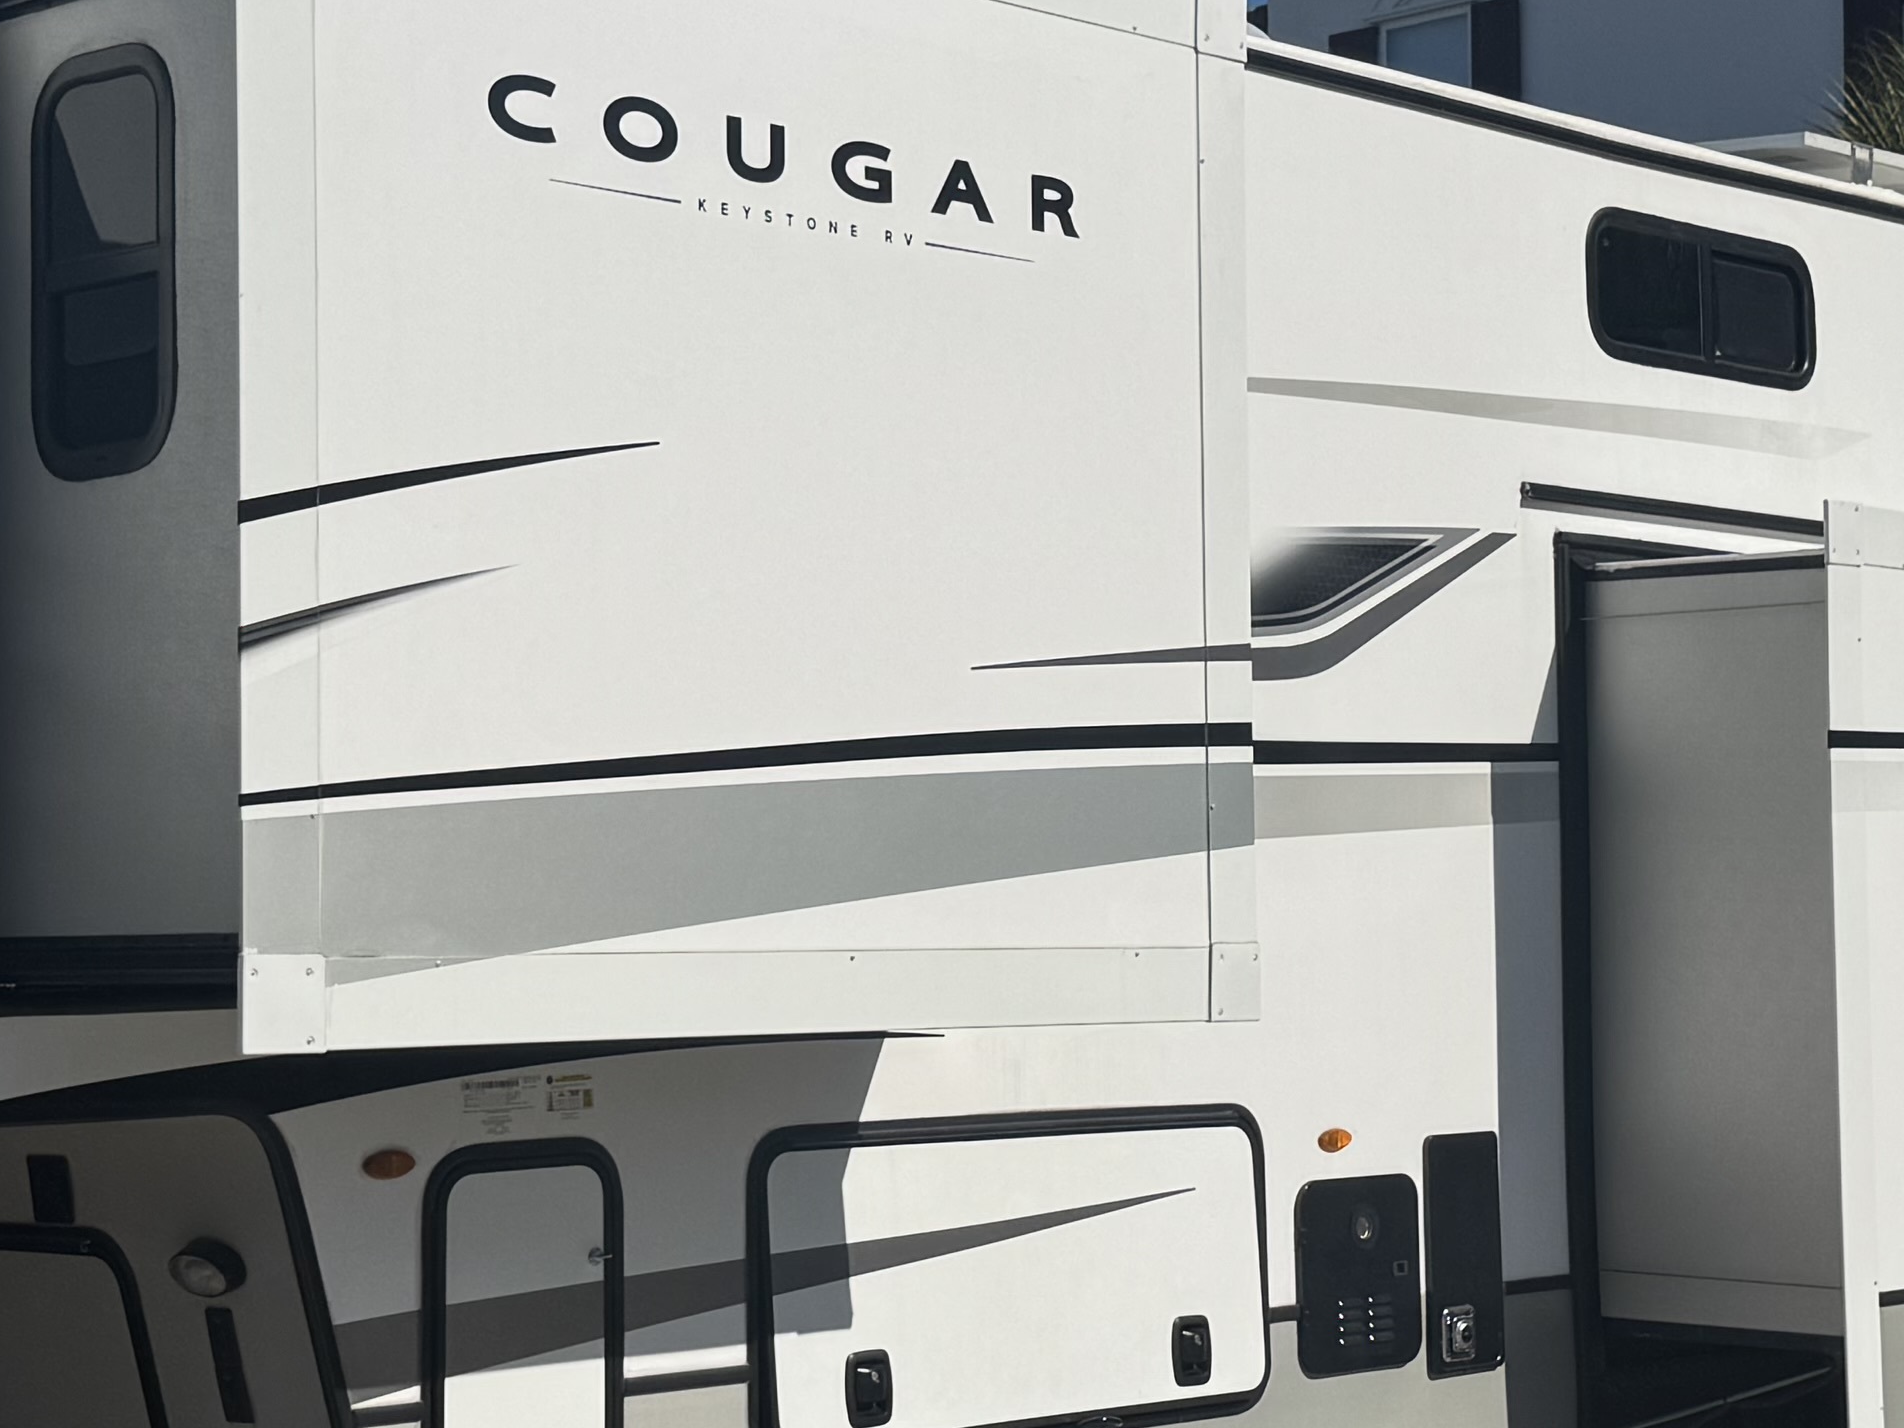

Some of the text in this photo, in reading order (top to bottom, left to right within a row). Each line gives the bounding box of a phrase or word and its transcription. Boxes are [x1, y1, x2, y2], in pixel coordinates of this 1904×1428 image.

[487, 74, 1080, 239] COUGAR
[698, 198, 913, 246] KEYSTONE RV
